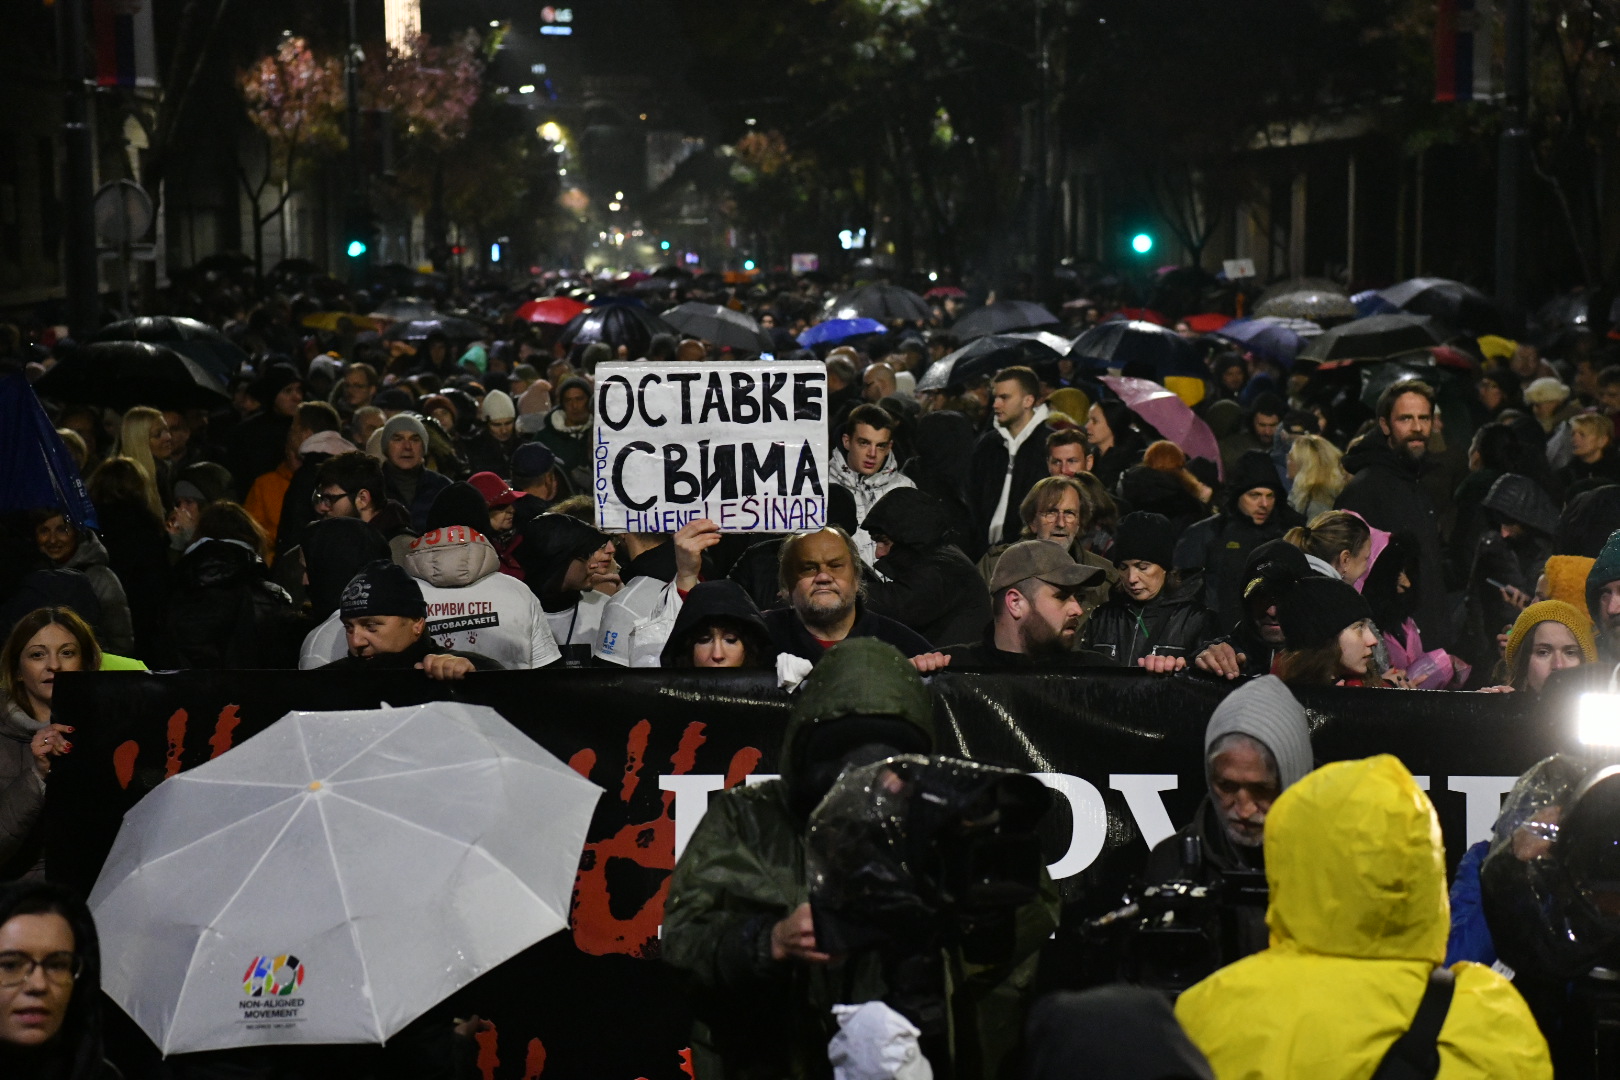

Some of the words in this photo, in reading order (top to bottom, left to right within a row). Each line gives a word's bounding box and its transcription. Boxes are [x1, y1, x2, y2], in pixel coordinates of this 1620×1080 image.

[599, 371, 826, 431] ОСТАВКЕ
[611, 439, 825, 511] СВИМА
[427, 602, 465, 616] КРИВИ
[467, 601, 492, 615] СТЕ!
[428, 615, 497, 633] ДГОВАРАЋЕТЕ
[239, 998, 305, 1009] NON-ALIGNED
[243, 1009, 299, 1019] MOVEMENT
